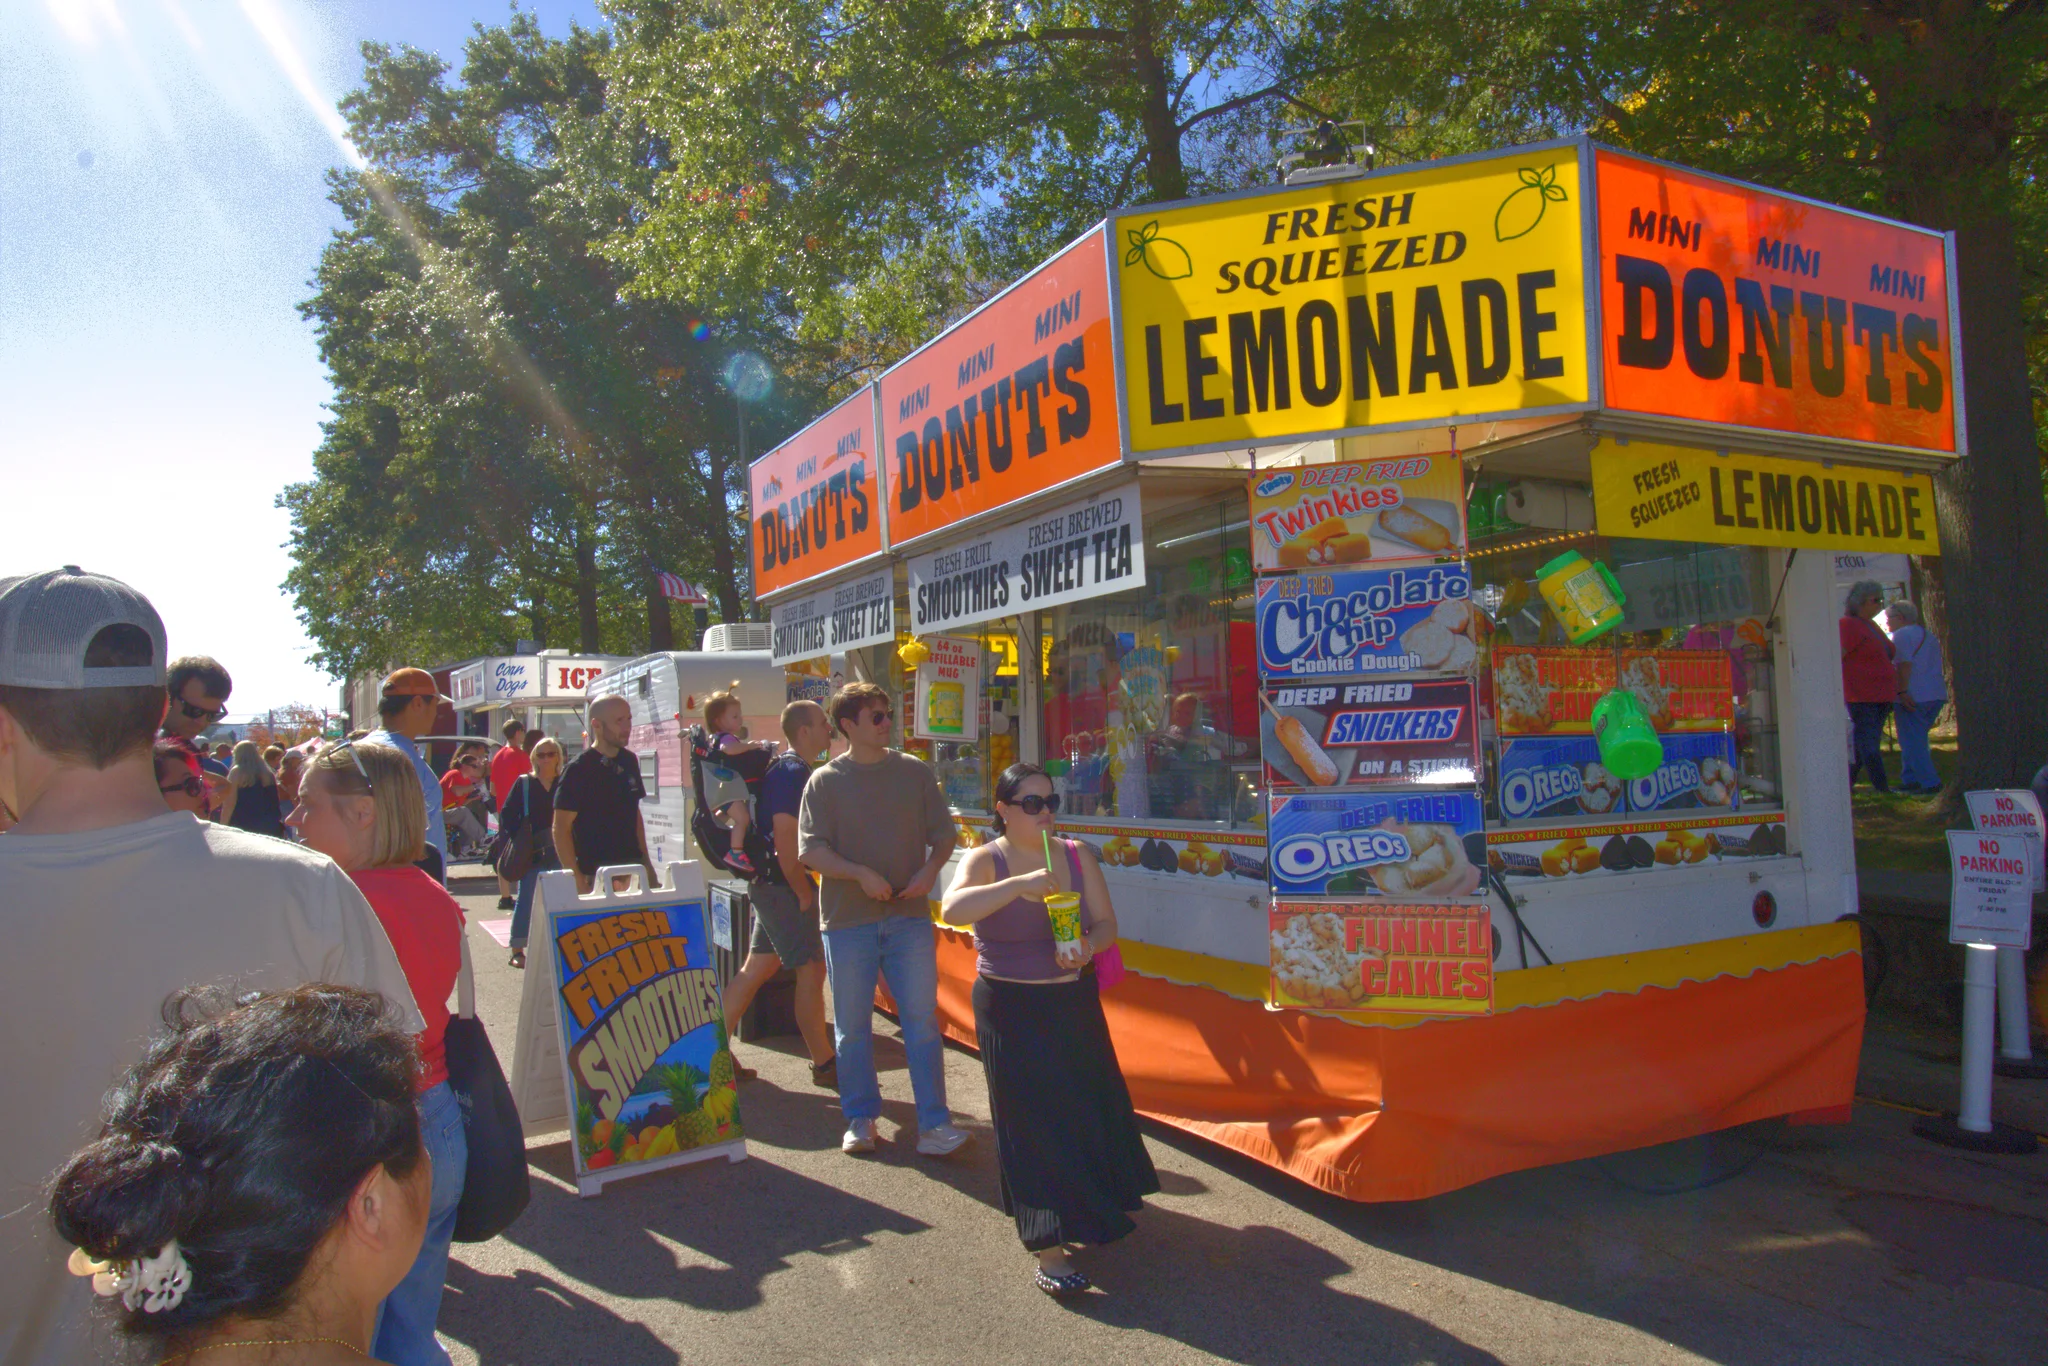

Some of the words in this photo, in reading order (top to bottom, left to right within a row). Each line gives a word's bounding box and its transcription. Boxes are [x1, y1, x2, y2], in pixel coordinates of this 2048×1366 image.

[1263, 192, 1416, 246] FRESH
[1216, 230, 1467, 296] SQUEEZED
[1628, 207, 1702, 252] MINI
[1756, 237, 1820, 279] MINI
[1870, 263, 1925, 302] MINI
[1144, 269, 1564, 426] LEMONADE
[1615, 254, 1943, 414] DONUTS
[900, 384, 930, 424] MINI
[958, 343, 994, 390] MINI
[1035, 290, 1081, 345] MINI
[896, 335, 1091, 514] DONUTS
[763, 477, 781, 503] MINI
[796, 456, 816, 484] MINI
[837, 428, 861, 460] MINI
[1300, 467, 1364, 488] DEEP
[1364, 458, 1432, 481] FRIED
[1633, 459, 1681, 495] FRESH
[761, 459, 868, 572] DONUTS
[1258, 486, 1399, 543] Twinkies
[1630, 482, 1700, 528] SQUEEZED
[1710, 467, 1925, 540] LEMONADE
[1028, 517, 1063, 549] FRESH
[1068, 498, 1122, 536] BREWED
[934, 555, 961, 578] FRESH
[965, 541, 992, 568] FRUIT
[1020, 537, 1088, 601] SWEET
[1092, 523, 1132, 584] TEA
[834, 586, 854, 608] FRESH
[856, 577, 884, 599] BREWED
[917, 560, 1009, 625] SMOOTHIES
[1278, 576, 1301, 598] DEEP
[1307, 575, 1334, 595] FRIED
[773, 615, 825, 659] SMOOTHIES
[831, 601, 869, 646] SWEET
[870, 596, 890, 636] TEA
[1261, 570, 1469, 667] Chocolate
[937, 640, 948, 650] 64
[952, 643, 963, 653] oz
[1319, 614, 1394, 661] Chip
[495, 663, 526, 677] Corn
[928, 653, 976, 667] EFILLABLE
[938, 666, 959, 679] MUG
[1292, 657, 1354, 674] Cookie
[1362, 652, 1421, 670] Dough
[1537, 658, 1616, 687] FUNNEL
[1659, 660, 1729, 687] FUNNEL
[496, 678, 528, 697] Dogs
[1277, 687, 1336, 707] DEEP
[1343, 683, 1413, 704] FRIED
[1668, 691, 1733, 720] CAKES
[1330, 709, 1461, 743] SNICKERS
[1359, 760, 1384, 774] ON
[1389, 760, 1404, 773] A
[1340, 803, 1388, 830] DEEP
[1396, 795, 1463, 823] FRIED
[1980, 813, 2036, 829] PARKING
[1995, 798, 2014, 811] NO
[1117, 828, 1155, 837] TWINKIES
[1162, 832, 1187, 840] FRIED
[1191, 833, 1235, 843] SNICKERS
[1489, 832, 1526, 843] OREOS
[1536, 829, 1568, 840] FRIED
[1572, 825, 1623, 837] TWINKIES
[1632, 822, 1661, 831] FRIED
[1665, 818, 1710, 830] SNICKERS
[1717, 816, 1745, 826] FRIED
[1748, 814, 1778, 824] OREOS
[1960, 855, 2024, 875] PARKING
[1978, 840, 2000, 855] NO
[1282, 904, 1345, 914] FRESH
[1353, 904, 1479, 916] HOMEMADE
[557, 911, 671, 973] FRESH
[1344, 917, 1488, 955] FUNNEL
[560, 936, 688, 1030] FRUIT
[1360, 959, 1489, 999] CAKES
[577, 967, 721, 1121] SMOOTHIES
